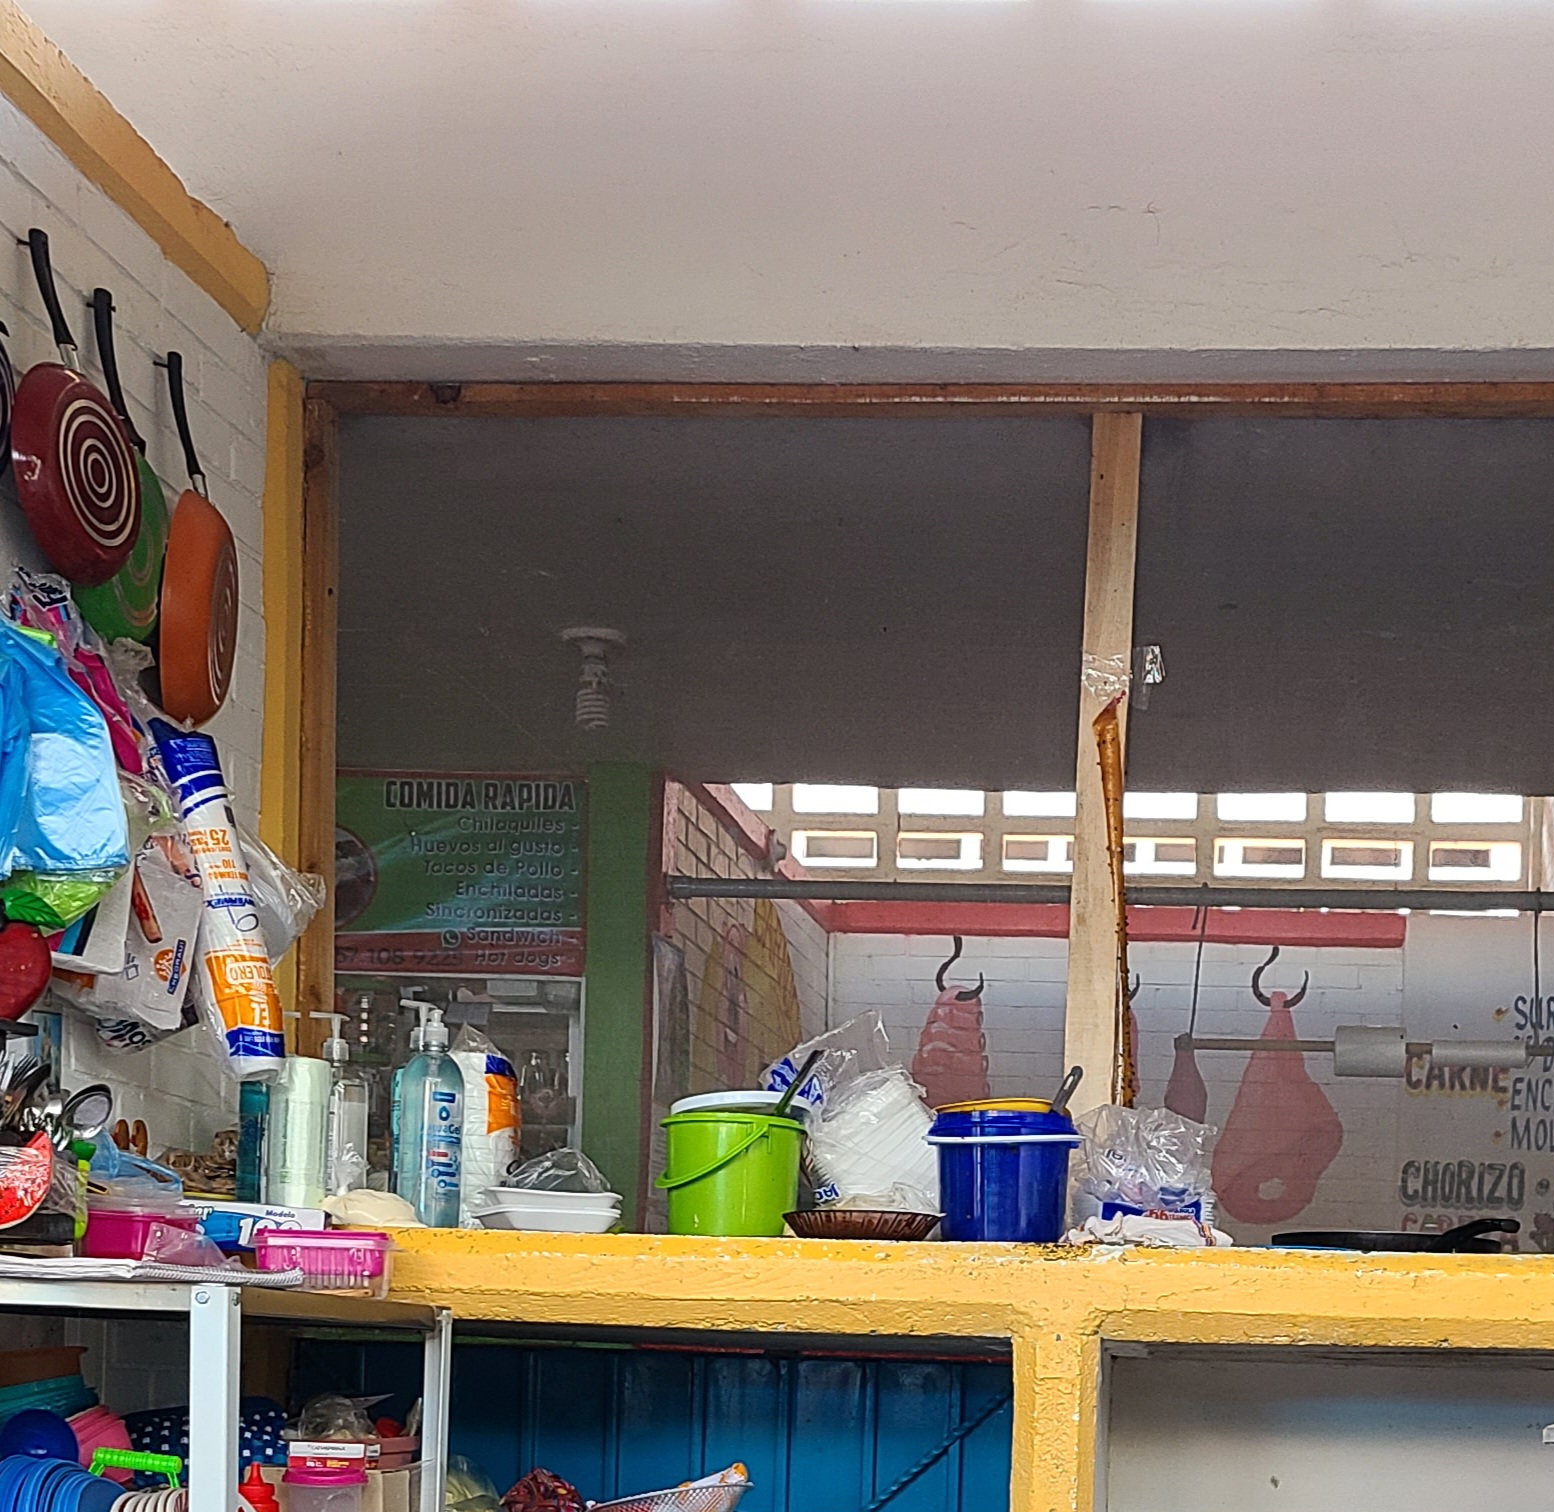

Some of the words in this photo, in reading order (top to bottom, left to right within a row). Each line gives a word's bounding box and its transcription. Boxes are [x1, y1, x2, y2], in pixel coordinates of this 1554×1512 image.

[384, 779, 477, 811] COMIDA
[482, 781, 576, 812] RAPIDA
[457, 816, 565, 835] Chilaquiles
[411, 836, 480, 855] Huevos
[487, 838, 505, 855] al
[510, 839, 564, 858] gusto
[424, 859, 476, 876] Tacos
[483, 860, 509, 876] de
[515, 861, 564, 878] Pollo
[455, 880, 564, 901] Enchiladas
[426, 902, 562, 923] Sincronizadas
[466, 927, 562, 946] Sandwich
[474, 951, 507, 966] Hot
[513, 952, 561, 970] dogs
[1401, 1159, 1526, 1211] CHORIZO
